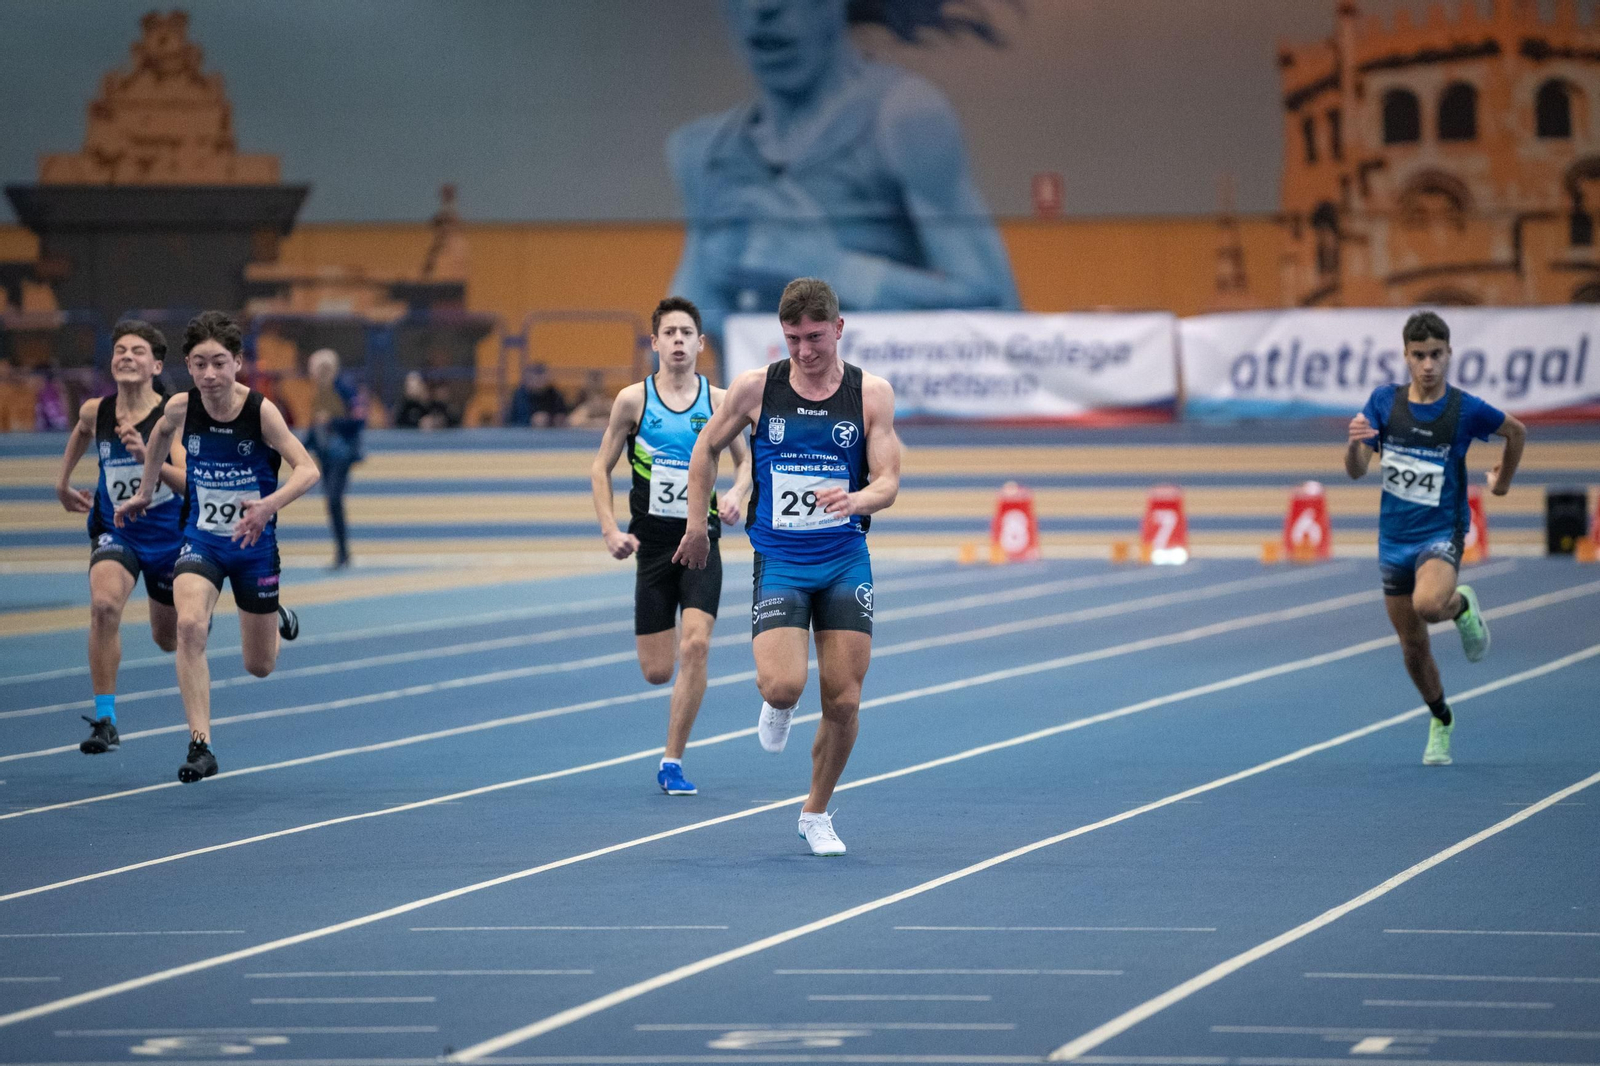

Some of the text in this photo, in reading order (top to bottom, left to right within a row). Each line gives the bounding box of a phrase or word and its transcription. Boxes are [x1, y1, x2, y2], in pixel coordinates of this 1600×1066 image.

[1229, 332, 1591, 400] atletiso.gal
[654, 457, 689, 467] OURENS
[775, 464, 821, 472] OURENSE
[798, 453, 838, 461] ATLETISMO
[193, 466, 253, 480] NARÓN
[196, 476, 257, 488] OURENSE 2026
[1387, 465, 1436, 493] 294
[657, 481, 689, 505] 34
[780, 490, 830, 516] 29
[1000, 509, 1029, 551] 8
[1152, 509, 1178, 551] 7
[1291, 508, 1323, 548] 6
